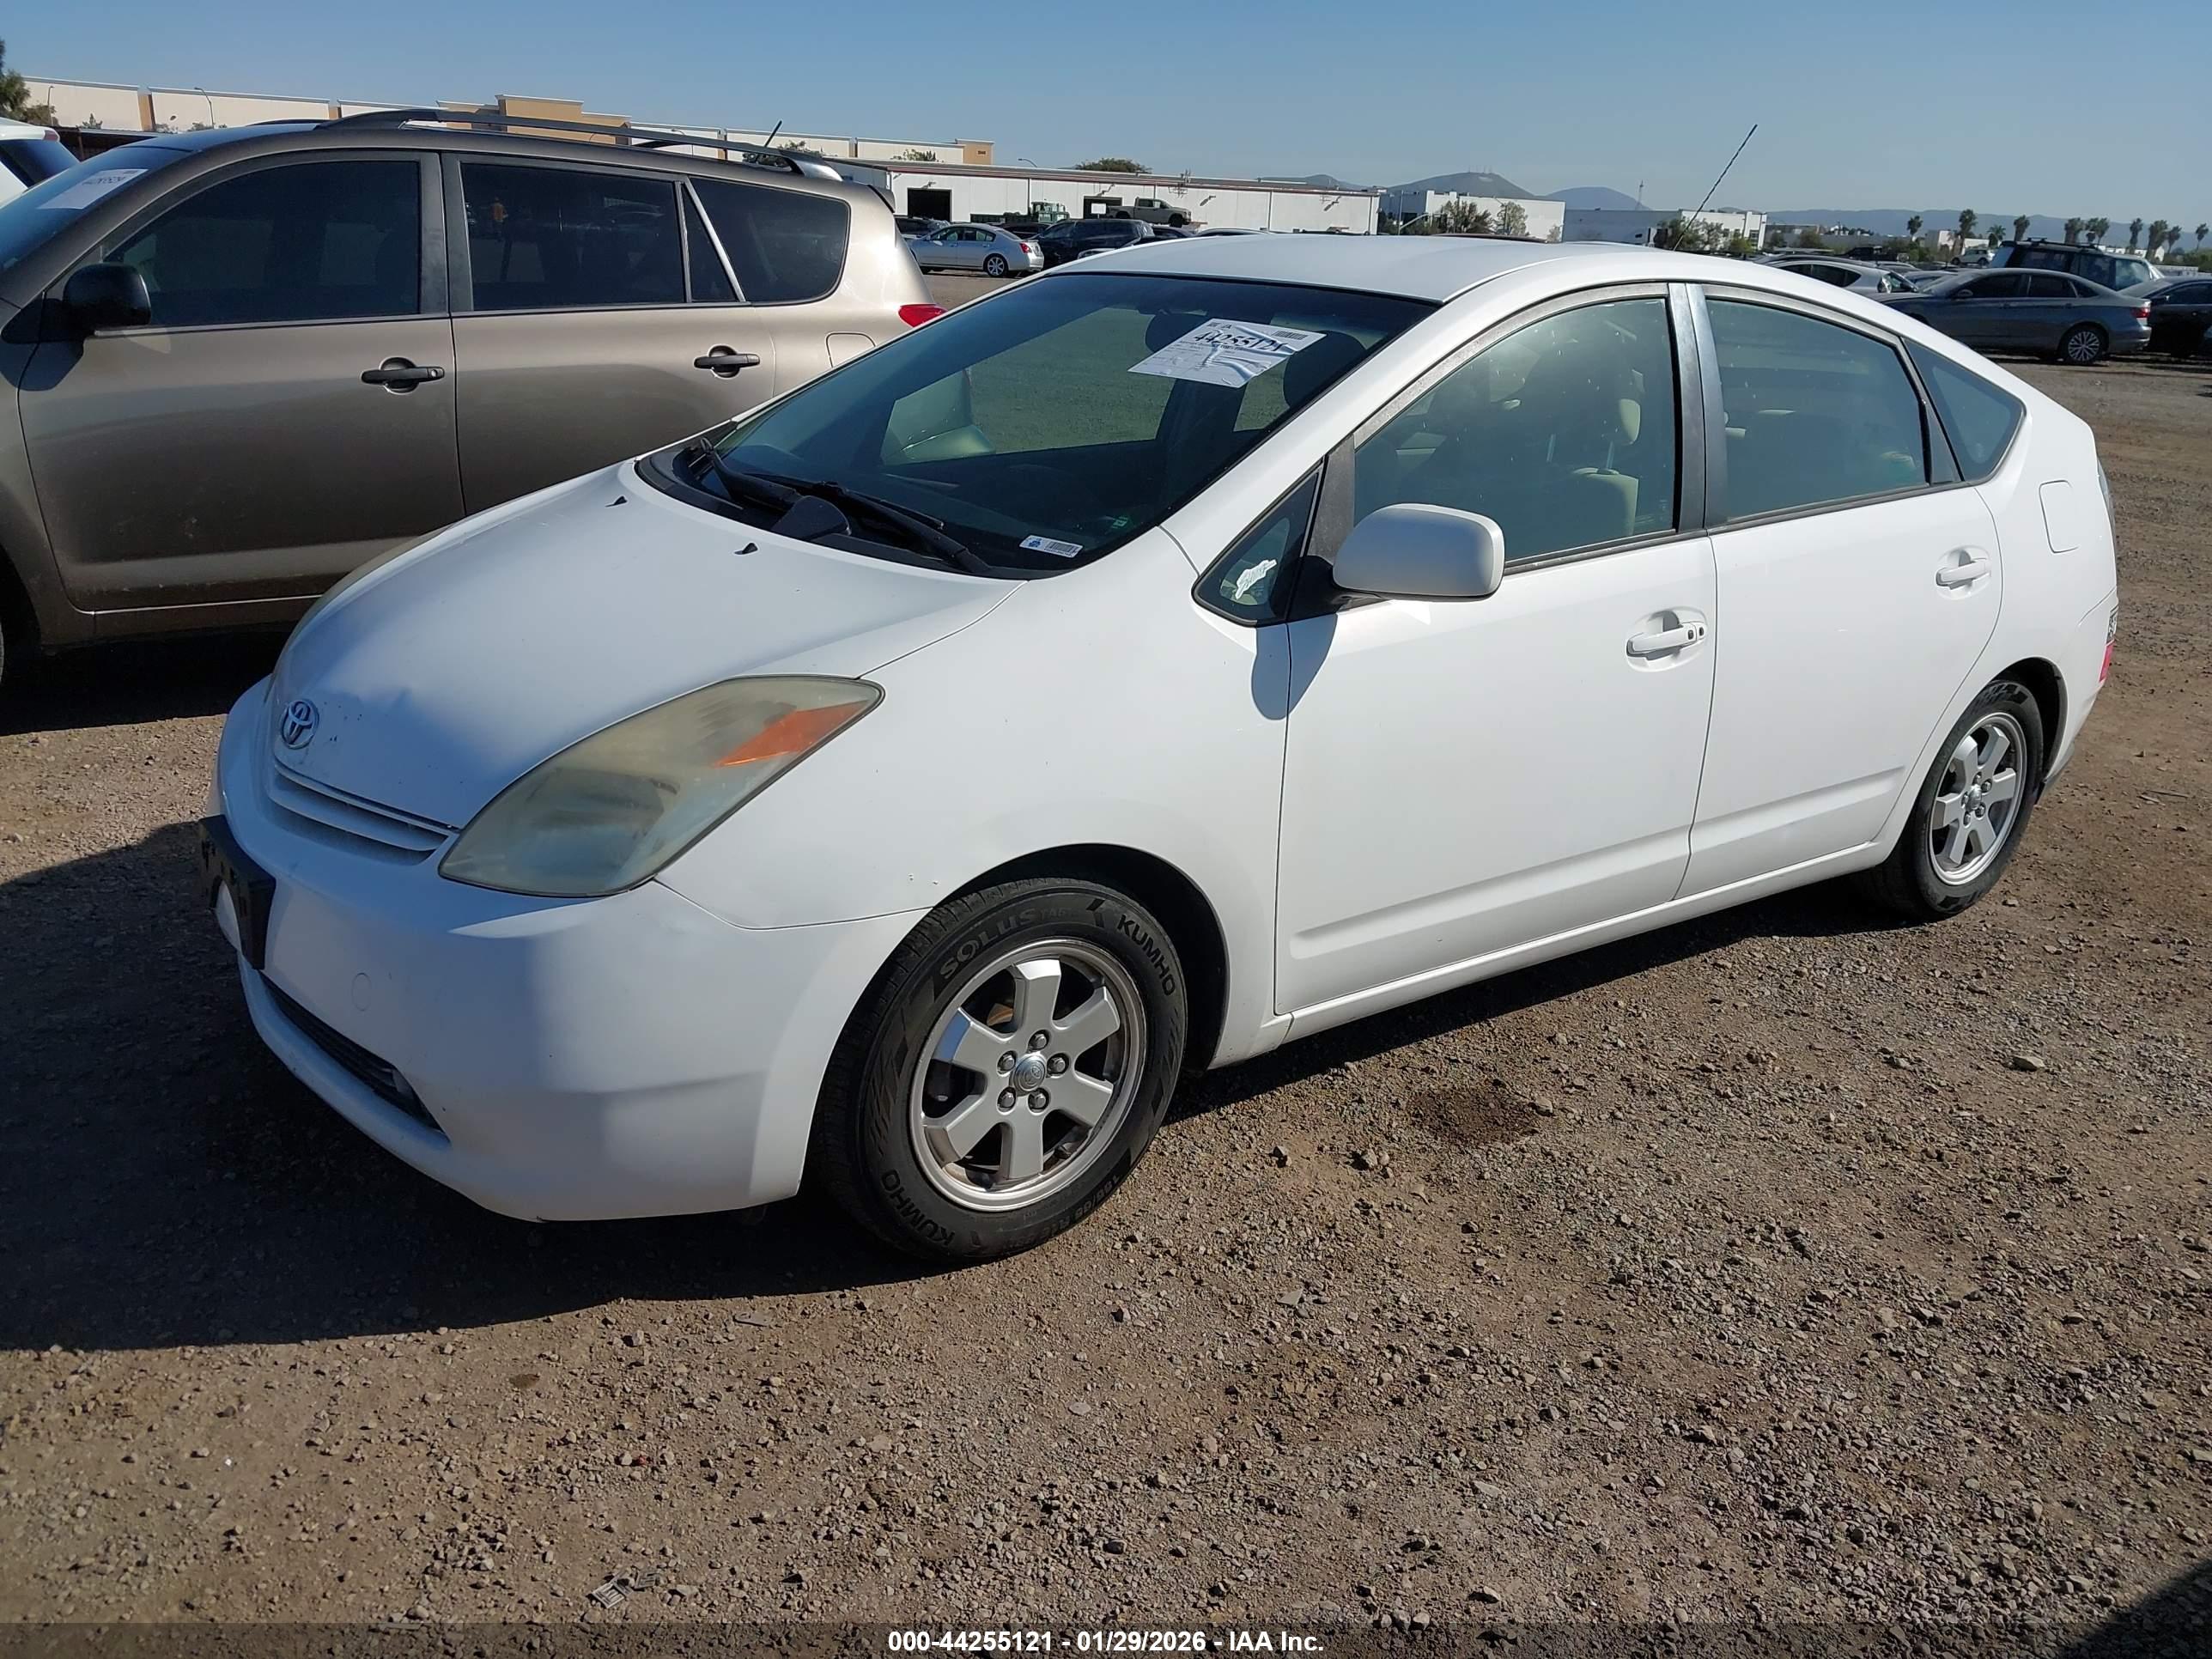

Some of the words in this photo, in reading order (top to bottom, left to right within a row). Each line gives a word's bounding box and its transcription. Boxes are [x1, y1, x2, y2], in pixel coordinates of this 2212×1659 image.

[1194, 329, 1289, 352] 44255121
[939, 908, 1037, 980] SOLUS
[1116, 913, 1176, 996] KUMHO
[880, 1169, 956, 1246] KUMHO
